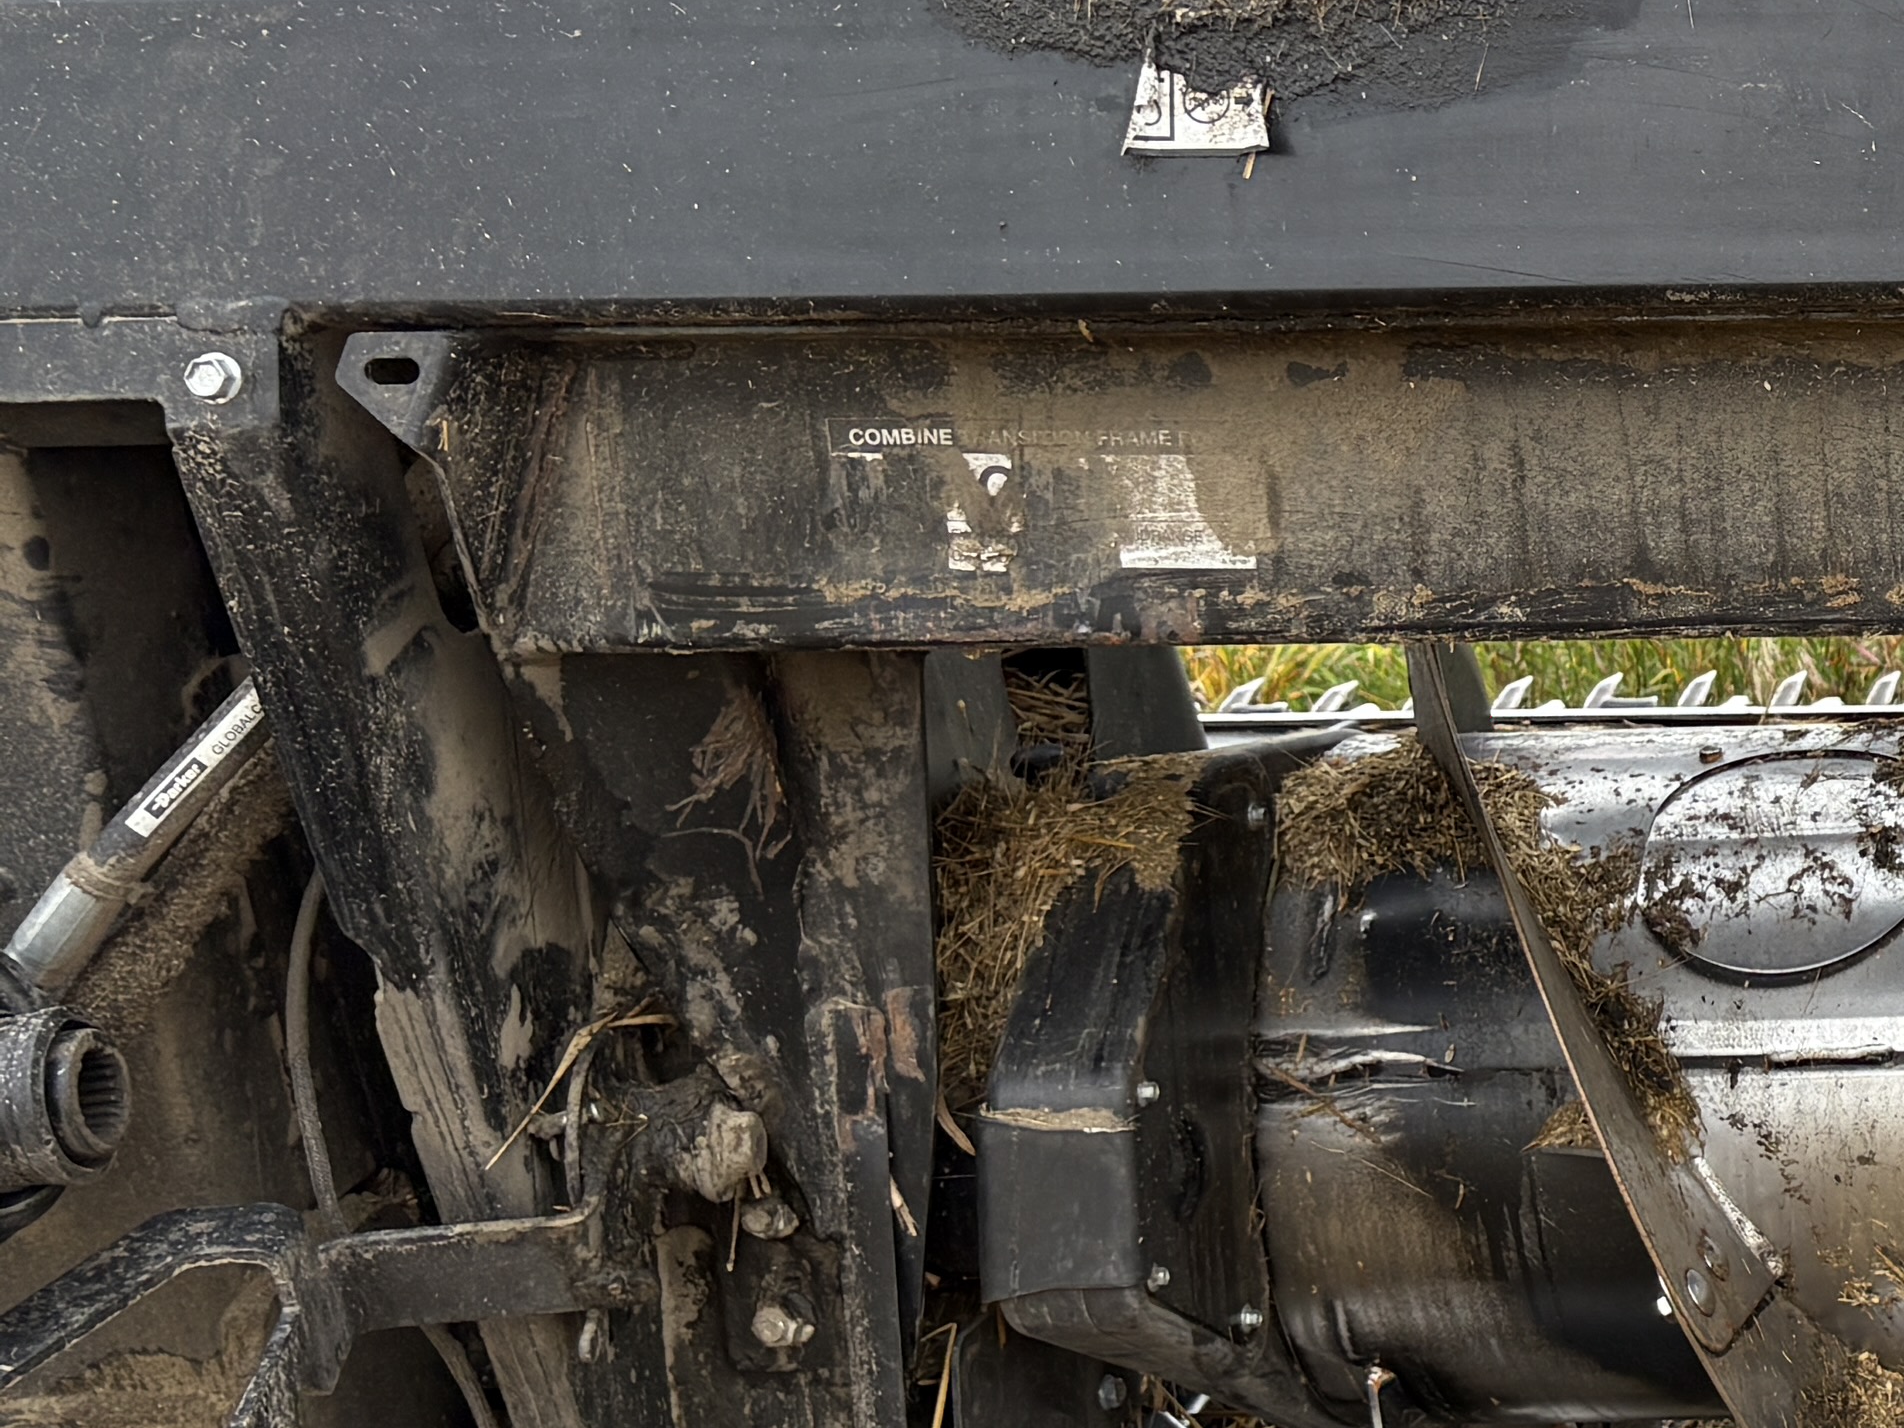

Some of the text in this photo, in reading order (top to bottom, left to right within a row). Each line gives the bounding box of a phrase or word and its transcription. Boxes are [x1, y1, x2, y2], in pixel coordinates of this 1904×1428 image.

[848, 427, 954, 447] COMBINE
[1096, 428, 1173, 447] FRAME
[153, 762, 200, 810] Parker
